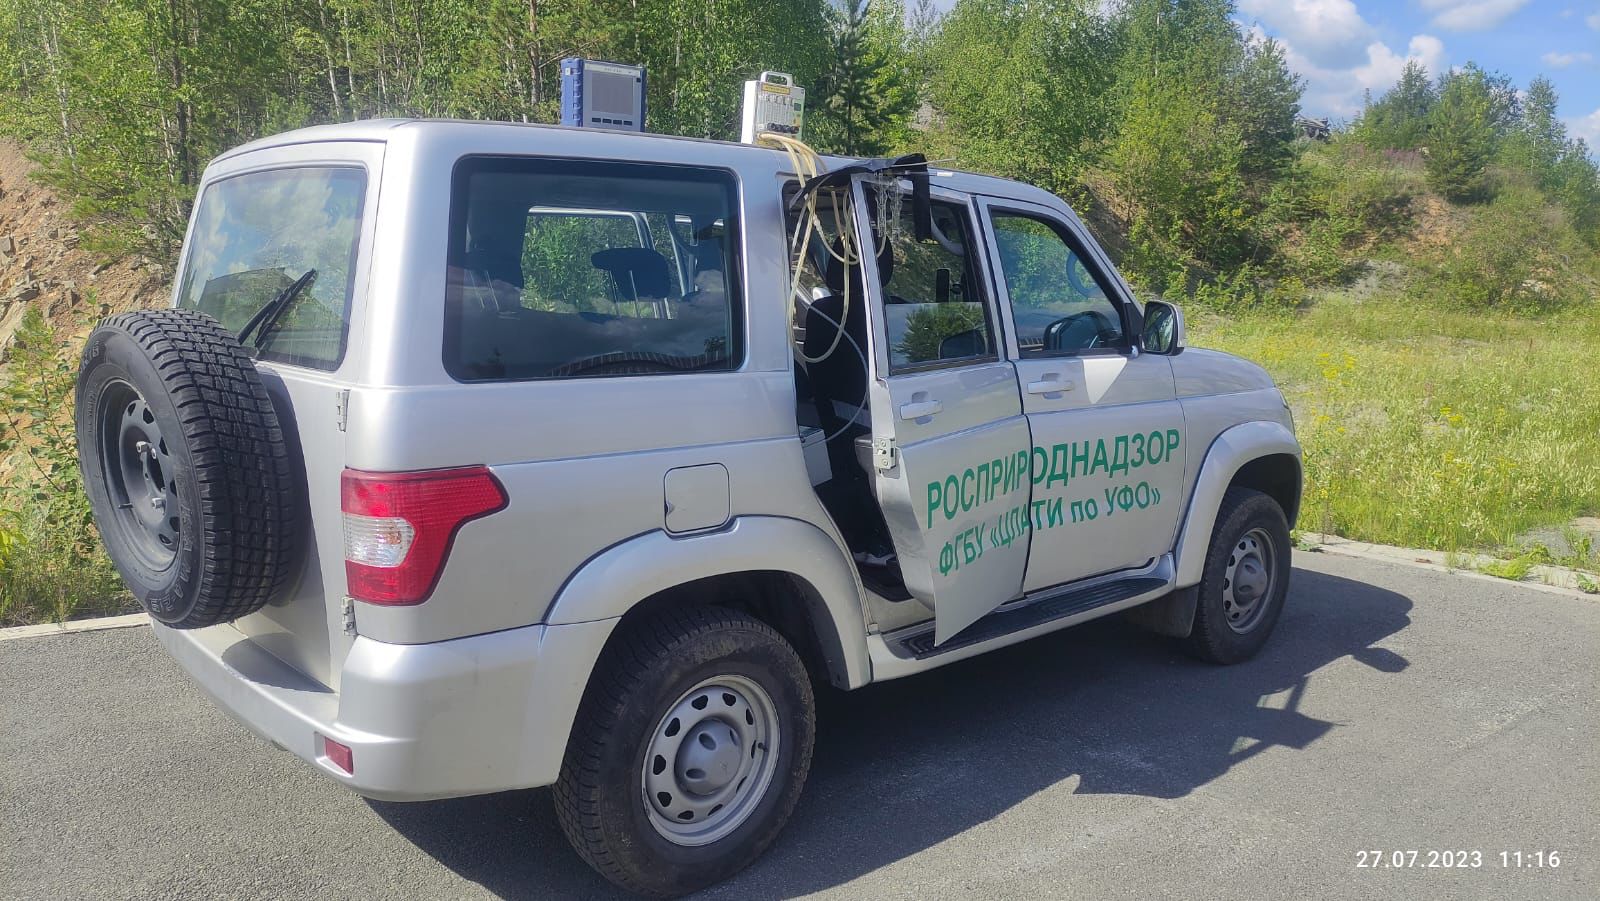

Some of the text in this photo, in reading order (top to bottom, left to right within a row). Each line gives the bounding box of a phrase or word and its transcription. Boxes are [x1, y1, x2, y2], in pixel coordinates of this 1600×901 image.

[927, 428, 1180, 529] РОСПРИРОДНАДЗОР
[938, 522, 986, 577] ФГБУ
[1070, 498, 1099, 523] по
[1104, 481, 1161, 516] УФО»
